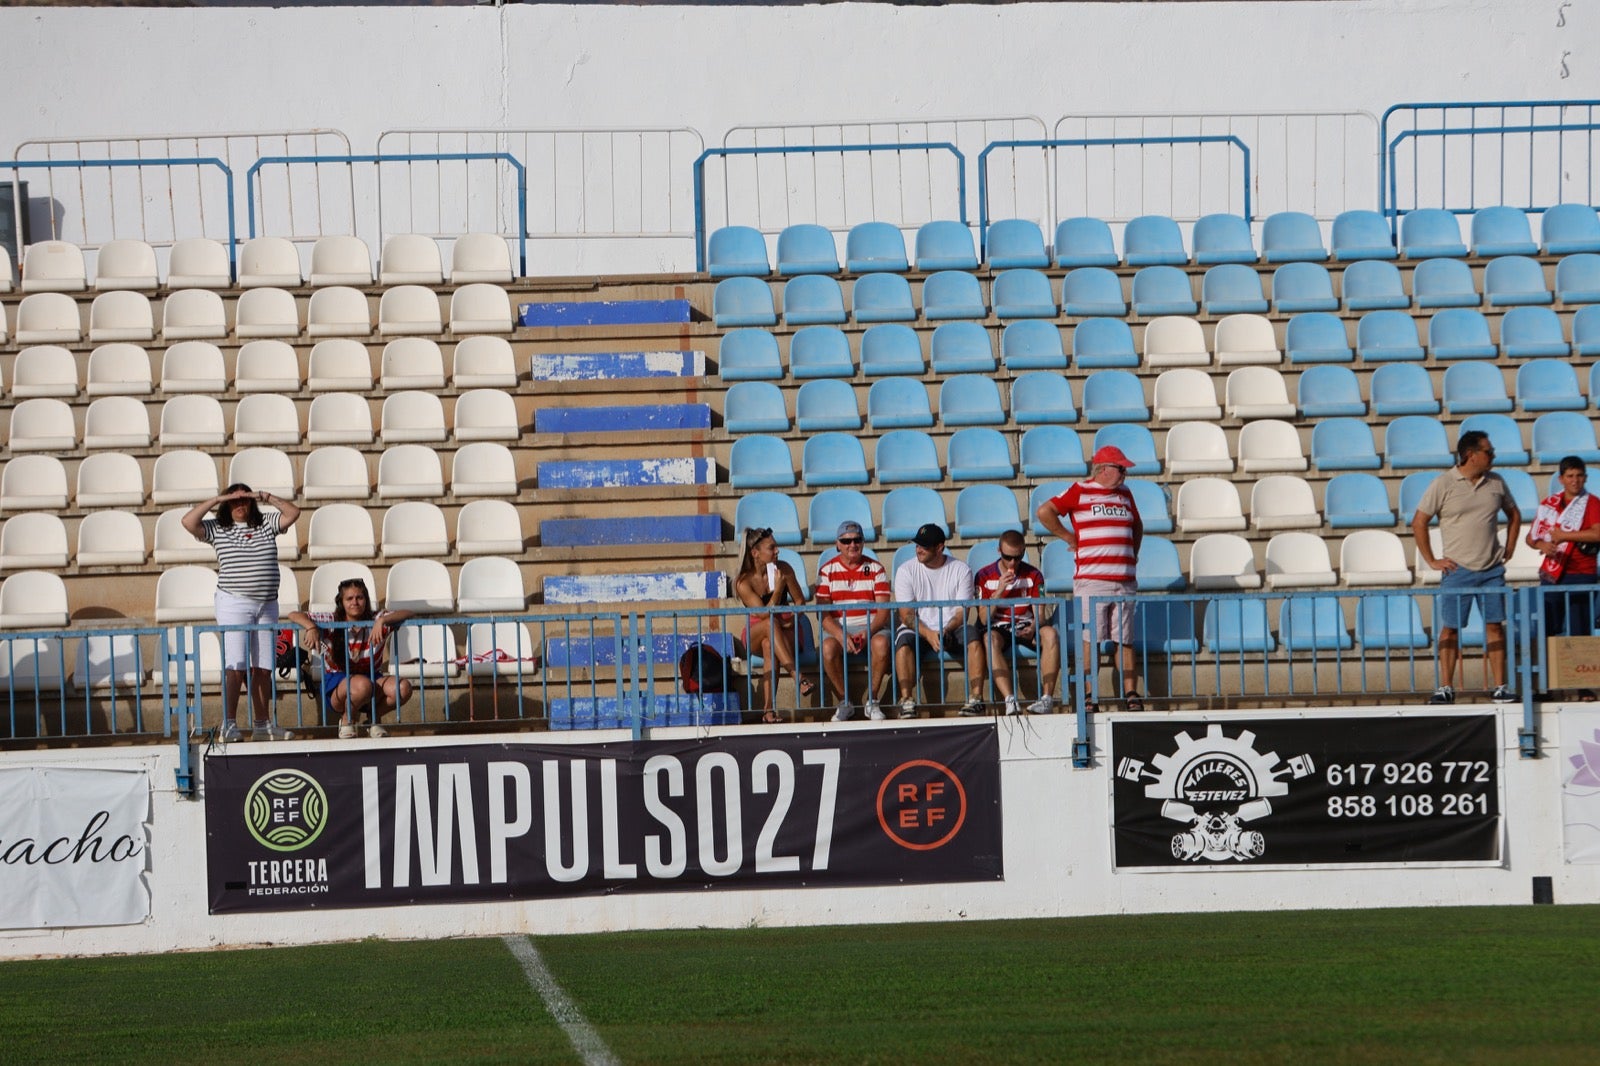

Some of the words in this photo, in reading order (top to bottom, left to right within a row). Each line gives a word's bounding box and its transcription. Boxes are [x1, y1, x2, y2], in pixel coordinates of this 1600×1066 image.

[1092, 505, 1128, 518] Platzi
[1184, 761, 1248, 788] TALLERES
[1326, 763, 1376, 786] 617
[1383, 762, 1433, 785] 926
[1441, 761, 1490, 783] 772
[1184, 790, 1248, 801] ESTEVEZ
[1327, 795, 1377, 818] 858
[1384, 794, 1434, 817] 108
[1441, 793, 1488, 815] 261
[361, 748, 841, 889] IMPULSO27
[0, 810, 143, 864] acho
[248, 858, 328, 885] TERCERA
[248, 884, 329, 896] FEDERACIÓN
